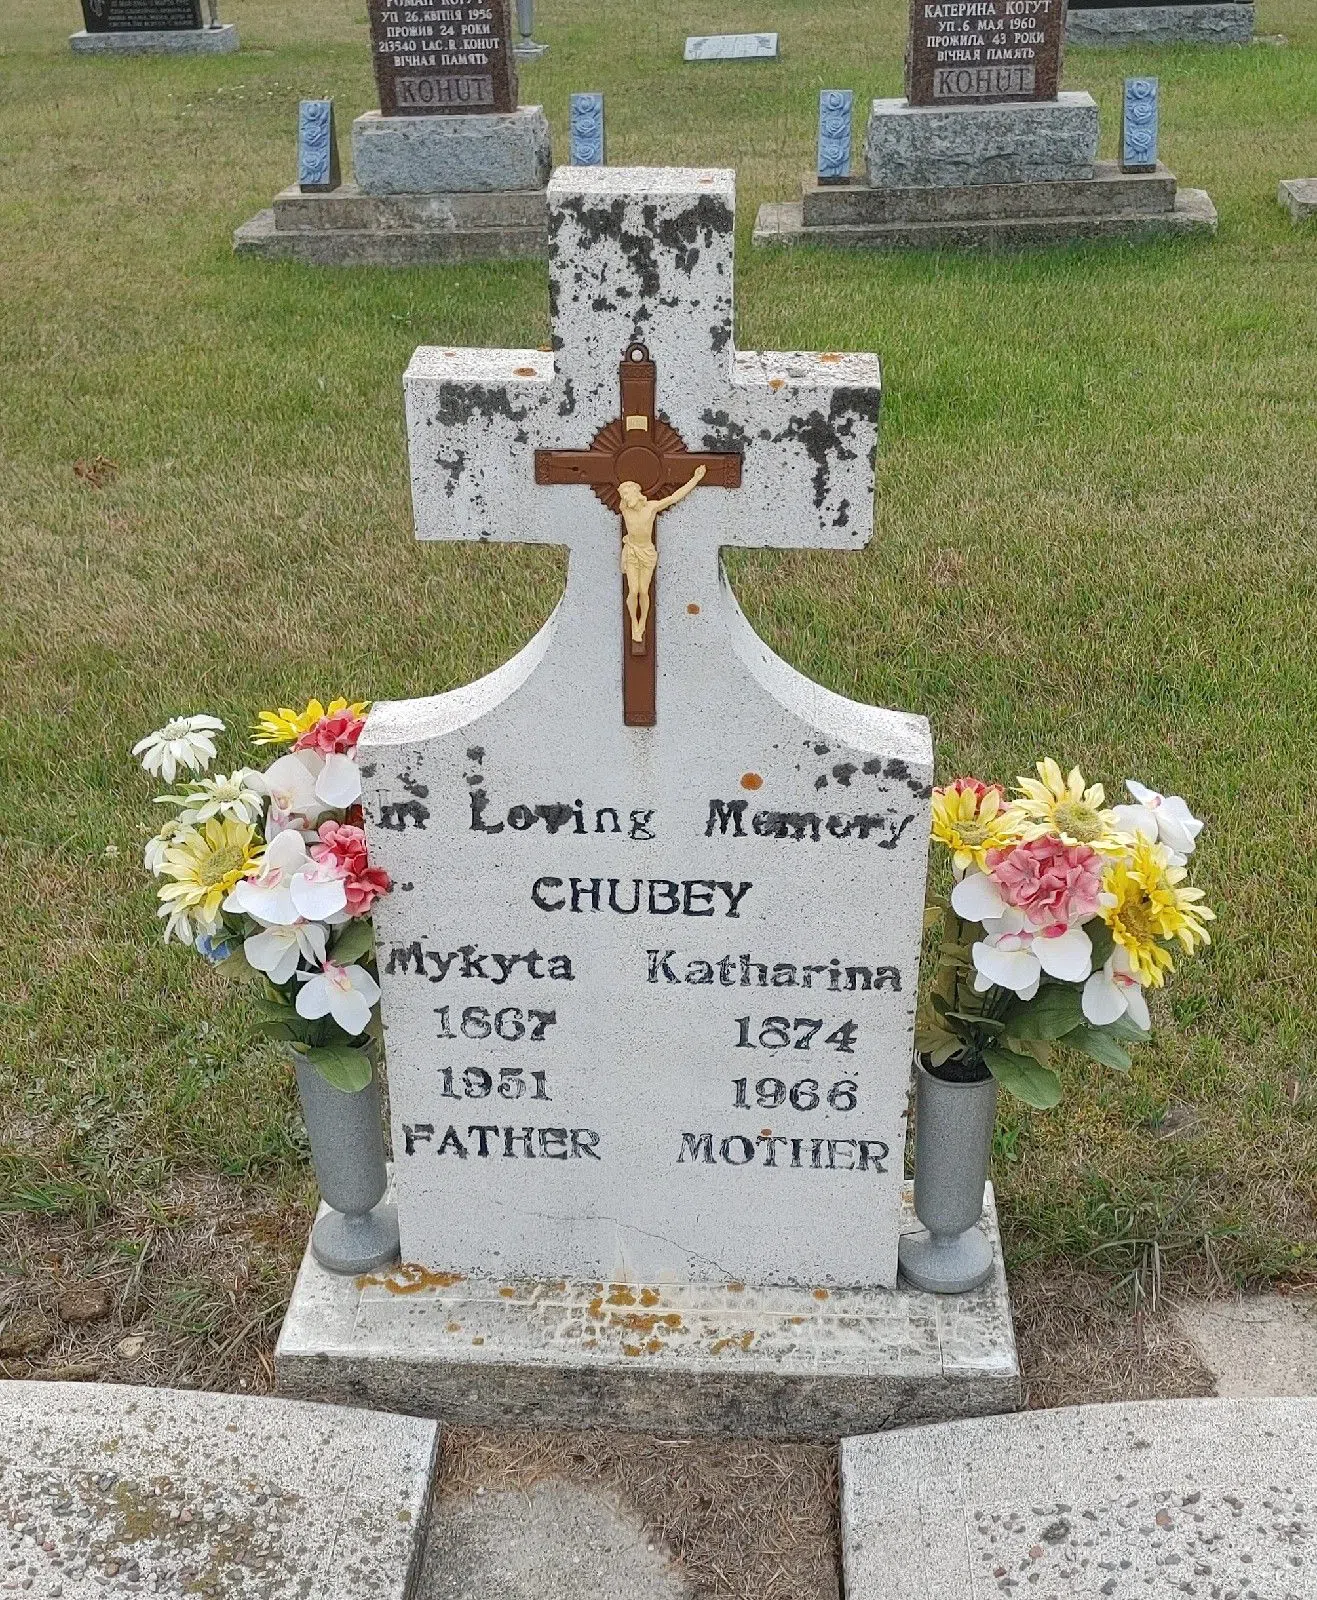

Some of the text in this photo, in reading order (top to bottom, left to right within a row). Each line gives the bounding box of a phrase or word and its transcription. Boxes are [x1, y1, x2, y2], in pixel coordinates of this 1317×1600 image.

[381, 11, 399, 23] УП
[924, 0, 1052, 18] КАТЕРИНА КОГУТ
[977, 19, 1004, 31] МАЯ
[1009, 17, 1036, 30] 1960
[386, 23, 491, 38] ПРОЖИВ 24 РОКИ
[926, 32, 1045, 48] ПРОЖИЛА 43 РОКИ
[378, 40, 417, 53] 213540
[441, 53, 489, 65] ПАМЯТЬ
[937, 48, 1036, 62] ВІЧНАЯ ПАМЯТЬ
[400, 77, 486, 103] KOHUT
[938, 67, 1031, 95] KOHUT
[375, 788, 915, 850] In Loving Memory
[531, 877, 754, 918] CHUBEY
[384, 940, 576, 985] Mykyta
[645, 949, 902, 993] Katharina
[433, 1005, 558, 1042] 1867
[734, 1015, 859, 1054] 1874
[438, 1067, 554, 1101] 1951
[730, 1077, 859, 1113] 1966
[402, 1124, 601, 1160] FATHER
[676, 1131, 890, 1173] MOTHER
